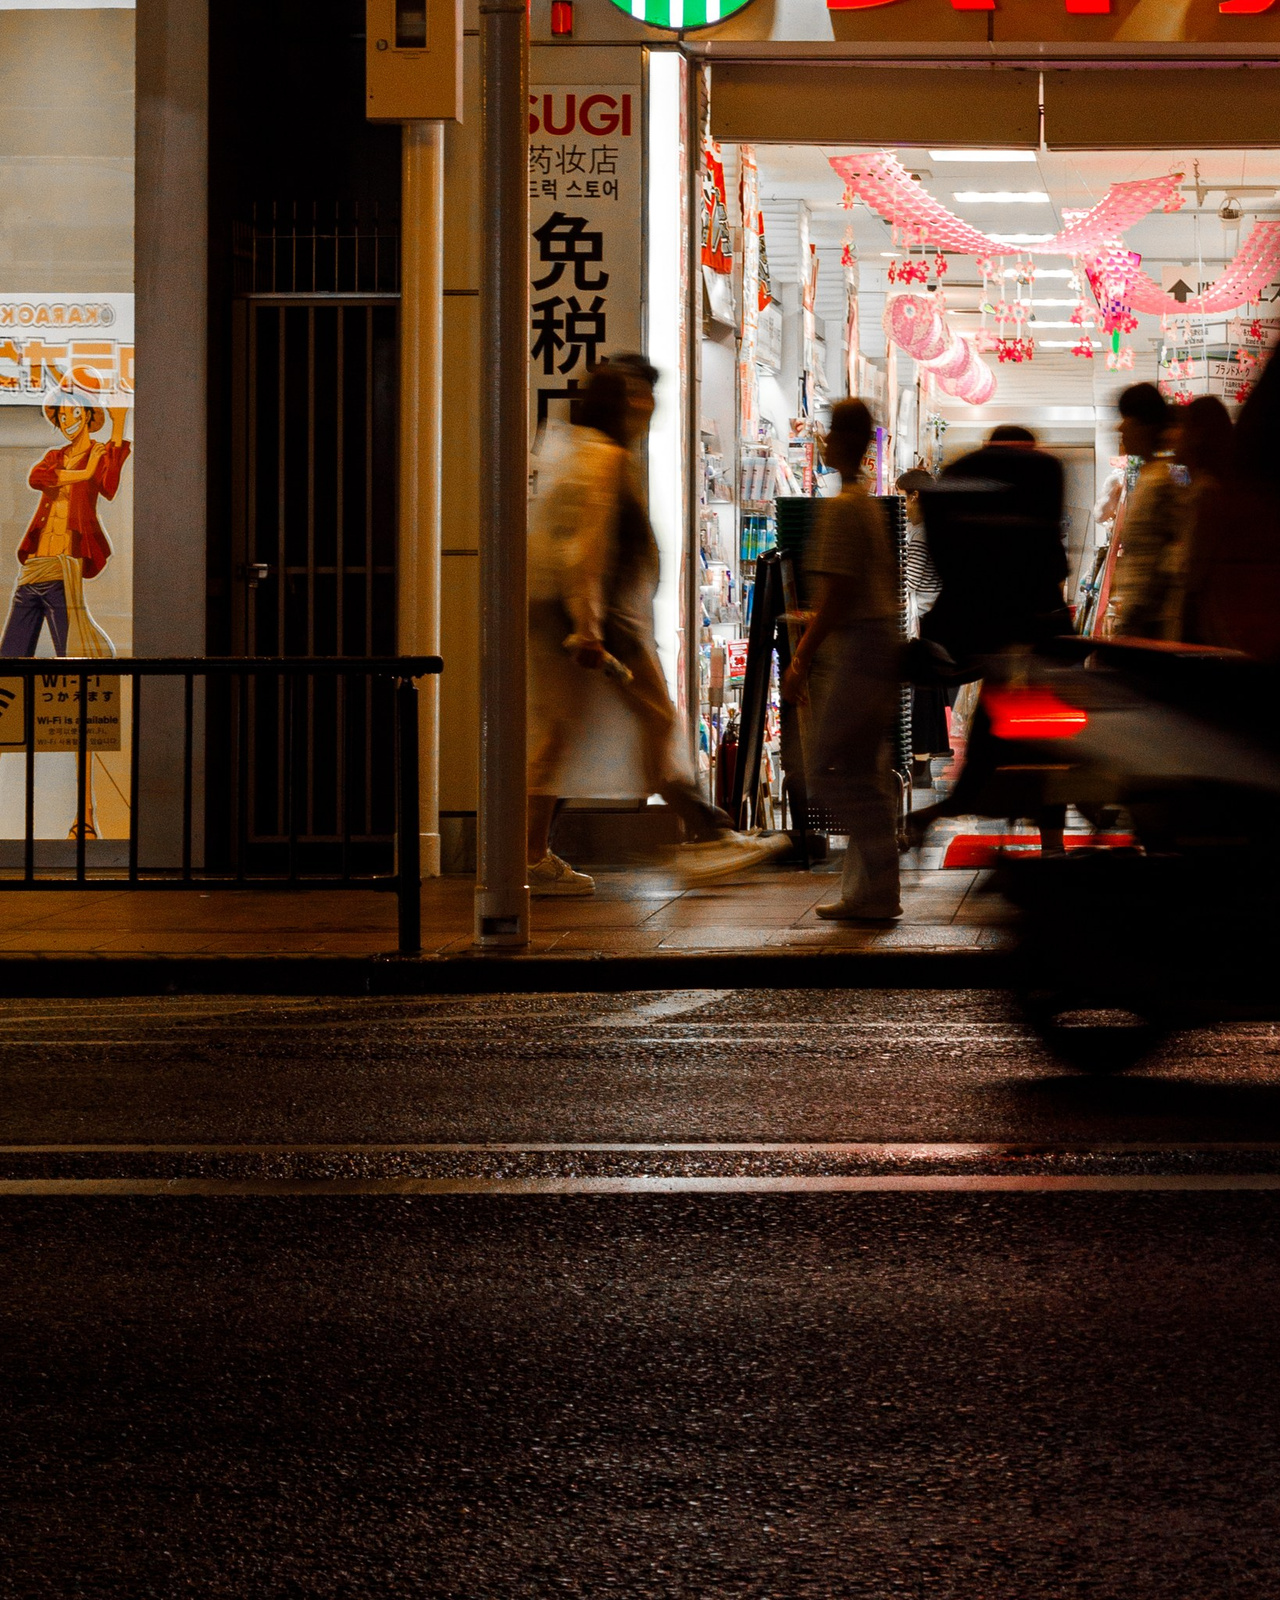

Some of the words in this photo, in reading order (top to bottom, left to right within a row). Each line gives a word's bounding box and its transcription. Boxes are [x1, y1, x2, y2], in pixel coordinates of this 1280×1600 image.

[529, 143, 618, 174] 药妆店
[565, 179, 618, 200] 스토어
[37, 716, 61, 724] Wi-Fi
[75, 716, 118, 724] aailable
